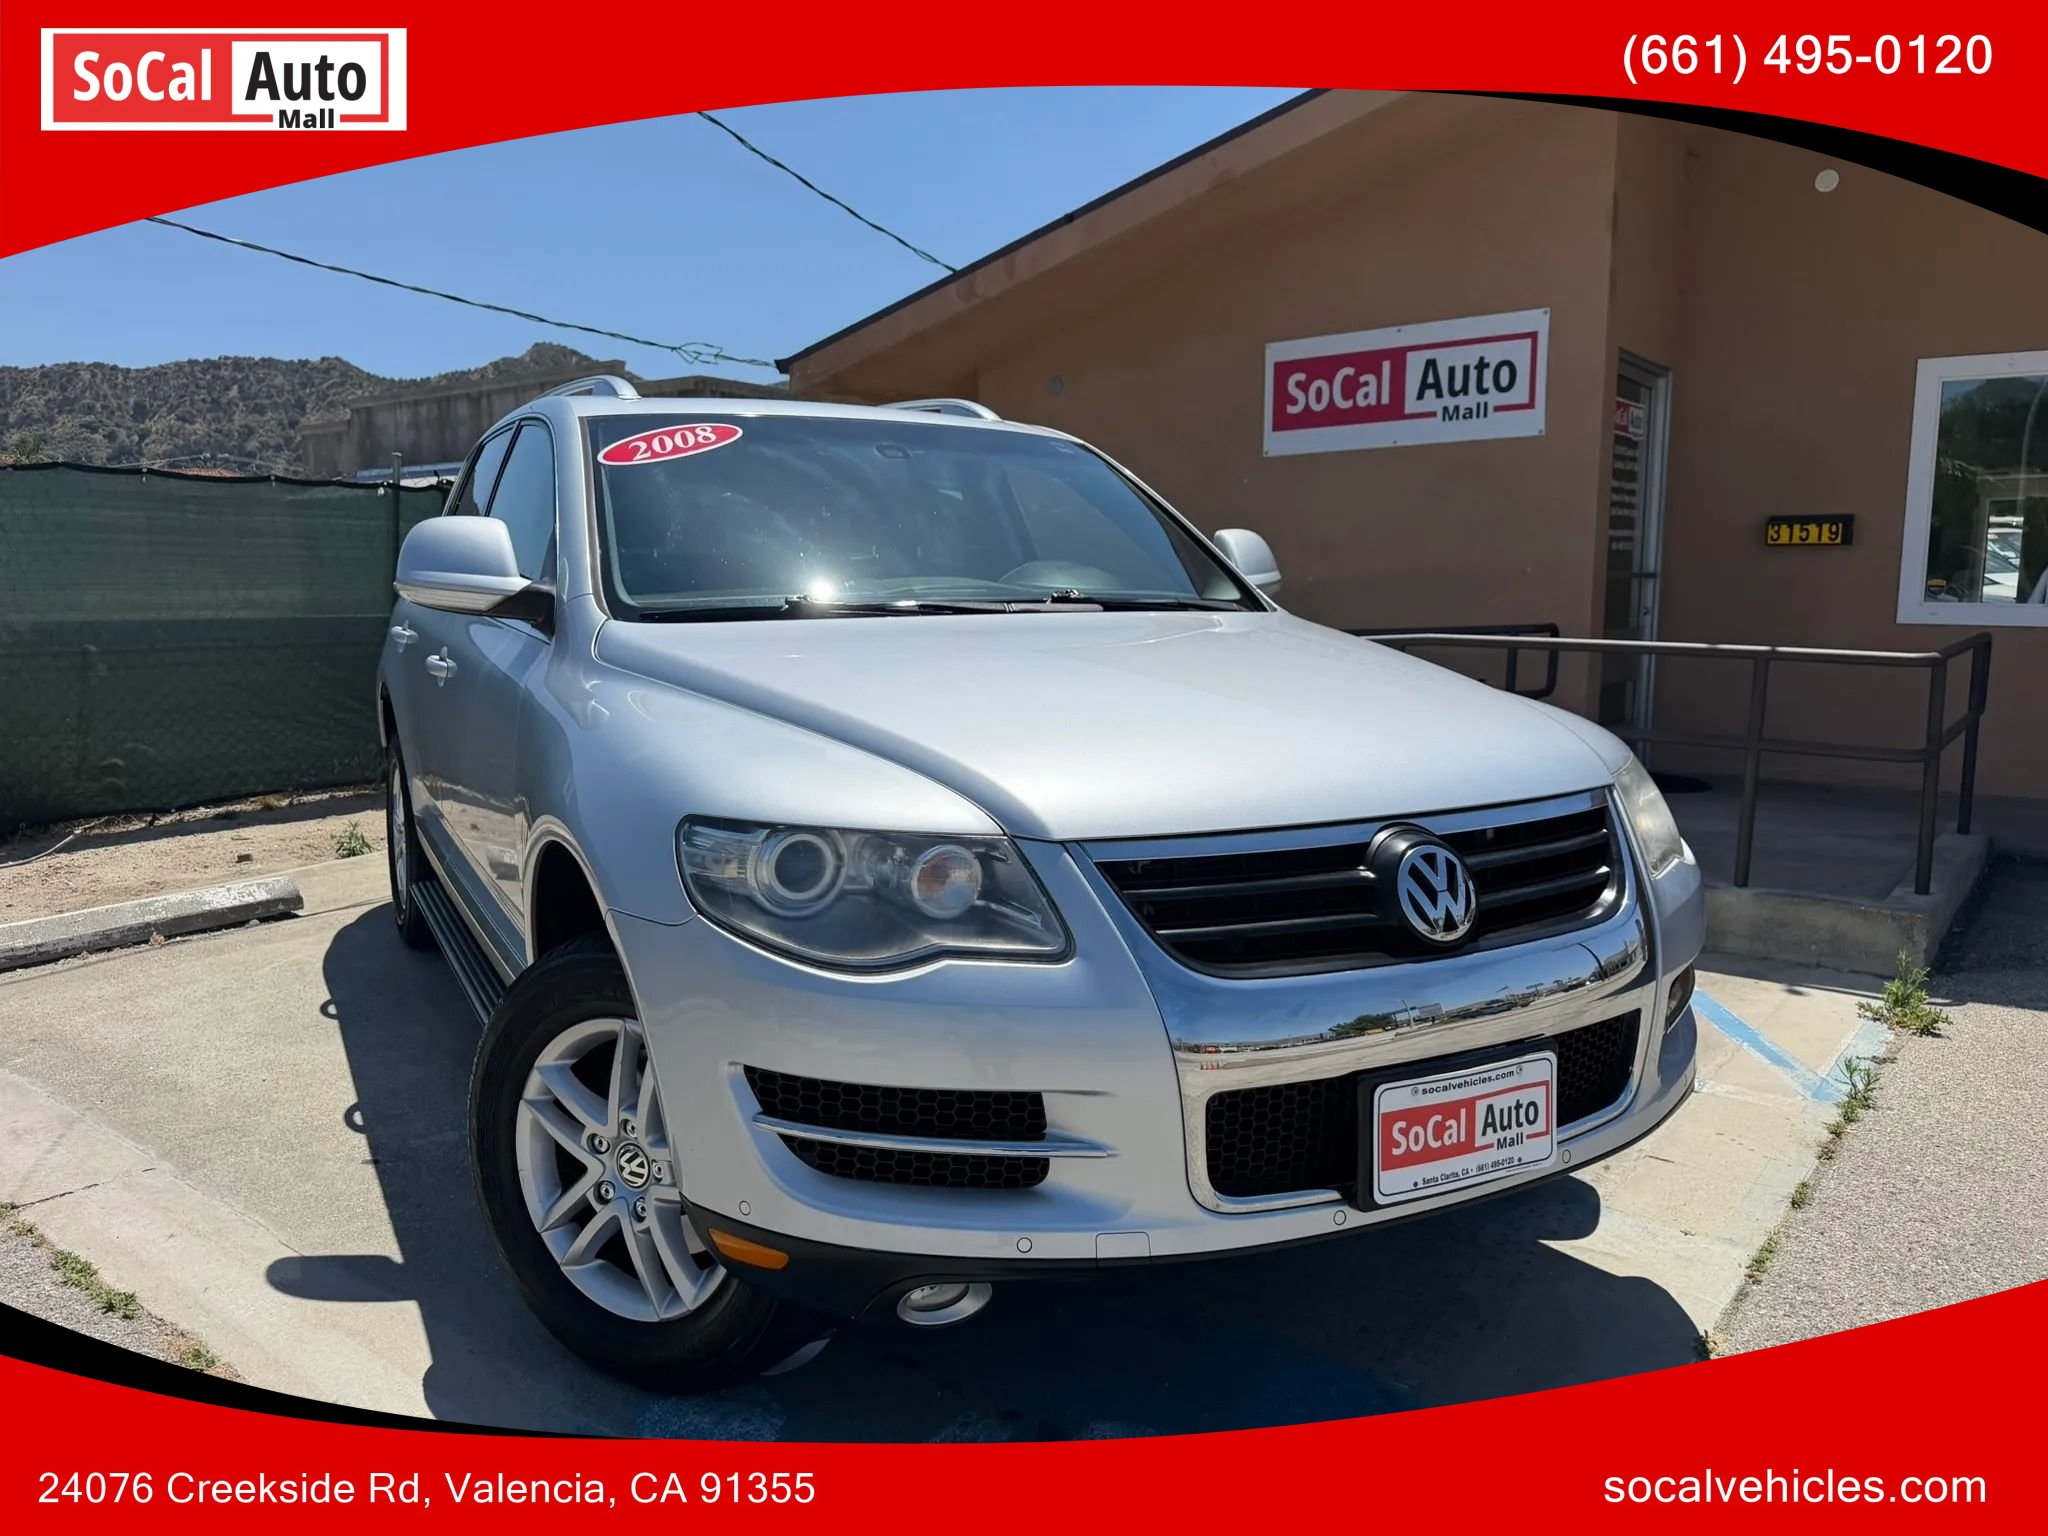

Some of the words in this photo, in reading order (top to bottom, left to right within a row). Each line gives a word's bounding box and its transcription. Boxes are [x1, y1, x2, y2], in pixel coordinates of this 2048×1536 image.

[1286, 360, 1391, 415] SoCal
[1415, 355, 1518, 401] Auto
[1441, 402, 1489, 422] Mall
[628, 425, 717, 461] 2008
[1769, 521, 1841, 544] 31519
[1421, 1070, 1515, 1095] socalvehicles.com
[1391, 1107, 1467, 1156] SoCal
[1481, 1098, 1540, 1137] Auto
[1496, 1132, 1524, 1151] Mall
[1422, 1175, 1439, 1186] Santa
[1461, 1167, 1470, 1177] CA
